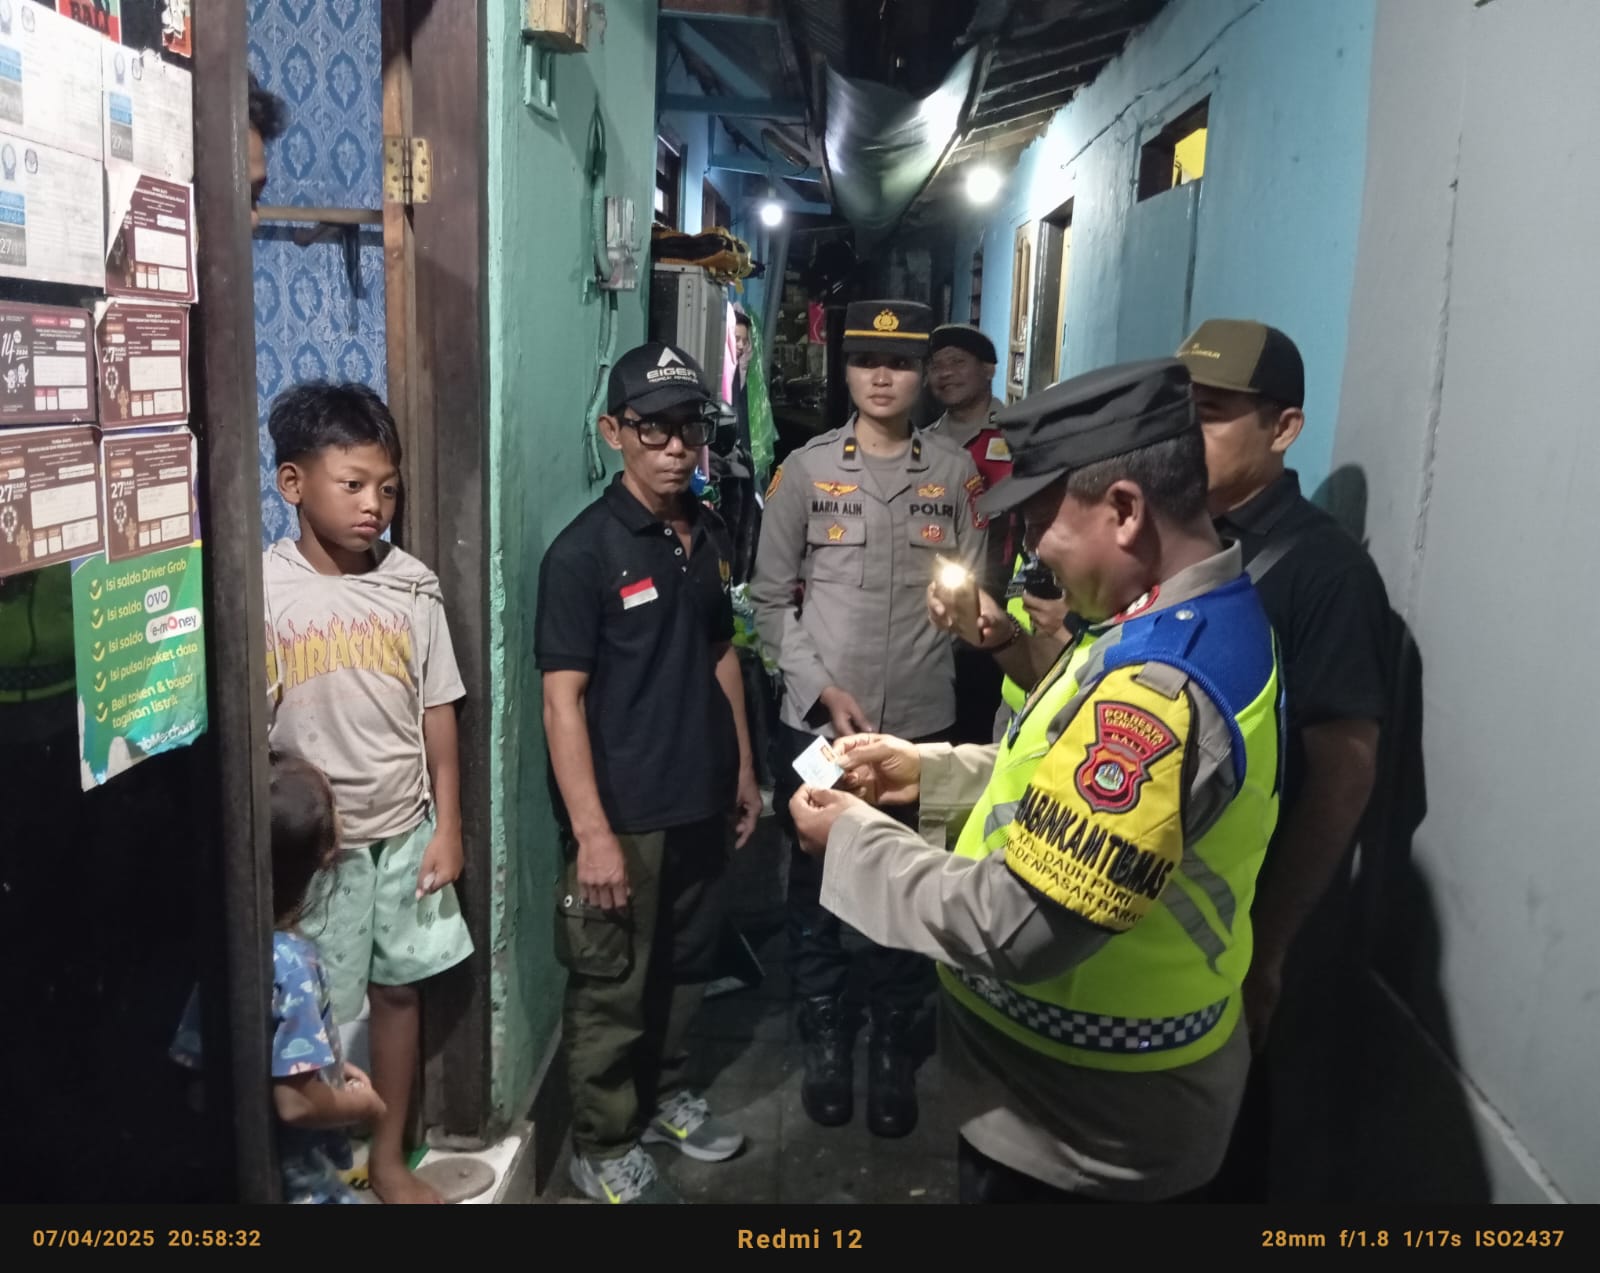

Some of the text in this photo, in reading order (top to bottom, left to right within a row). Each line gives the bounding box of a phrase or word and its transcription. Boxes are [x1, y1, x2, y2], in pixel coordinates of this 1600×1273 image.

[646, 367, 698, 380] EIGER
[111, 481, 124, 499] 27
[910, 503, 953, 517] POLRI
[106, 558, 187, 592] Isi saldo Driver Grab
[107, 590, 168, 621] Isi saldo OVO
[109, 638, 118, 653] Isi
[120, 631, 143, 649] saldo
[176, 643, 198, 657] data
[156, 680, 166, 693] &
[1111, 732, 1142, 753] BALI
[1043, 850, 1088, 882] DAUH
[1091, 878, 1132, 907] PURI
